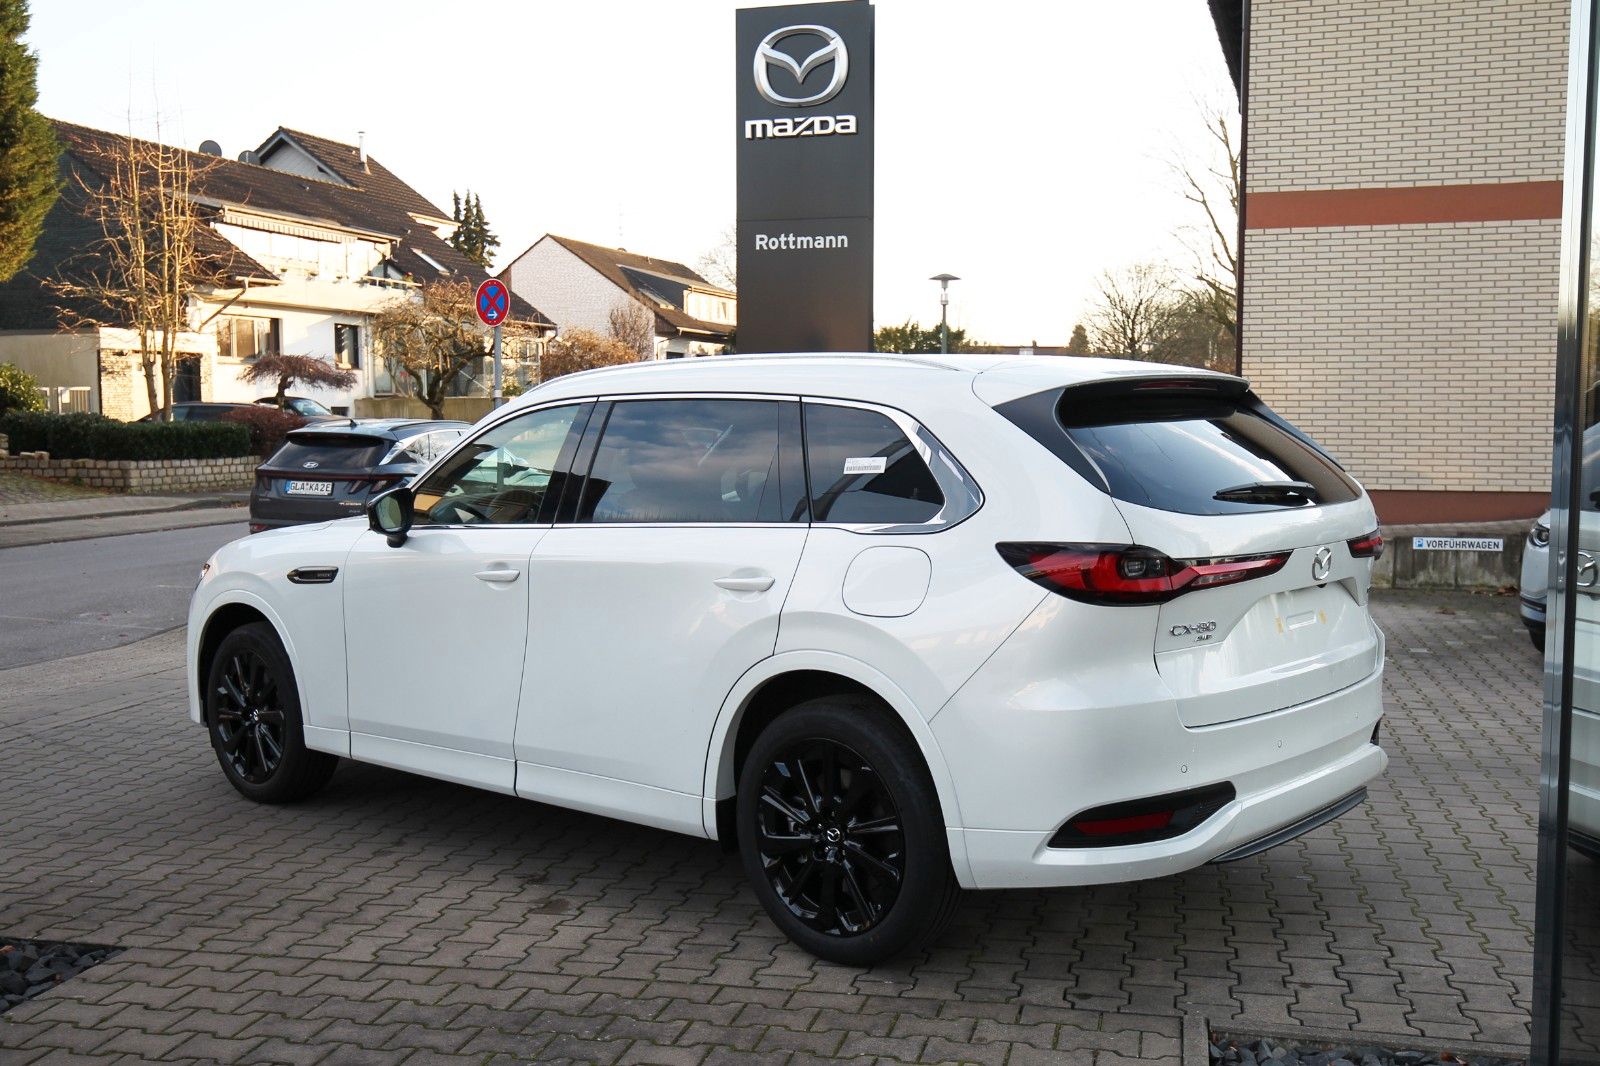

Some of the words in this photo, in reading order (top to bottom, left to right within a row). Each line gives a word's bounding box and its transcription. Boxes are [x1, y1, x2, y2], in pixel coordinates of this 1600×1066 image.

[745, 115, 857, 138] mazda
[755, 232, 849, 250] Rottmann
[1426, 539, 1500, 550] VORFÜHRWAGEN
